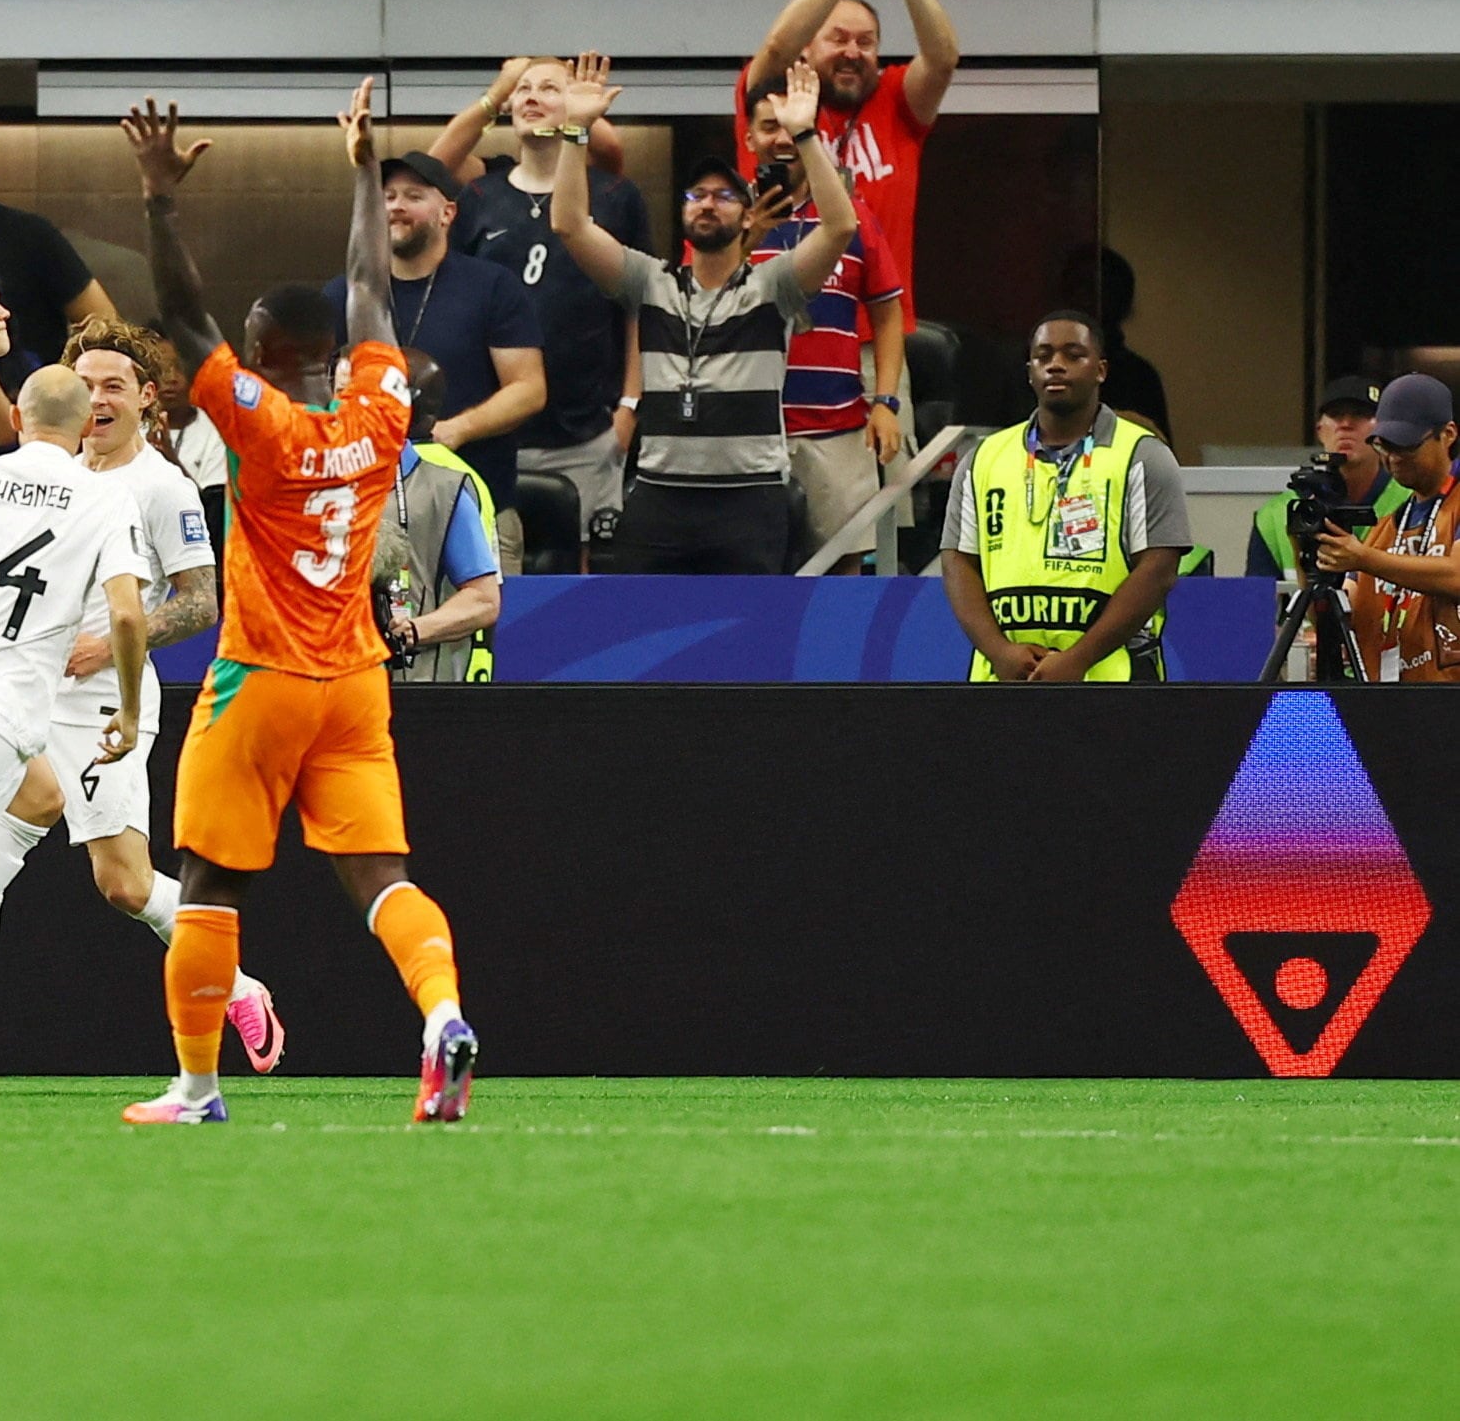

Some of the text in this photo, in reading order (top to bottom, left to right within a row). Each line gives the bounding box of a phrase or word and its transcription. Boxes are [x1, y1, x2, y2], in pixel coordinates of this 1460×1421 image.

[523, 243, 548, 285] 8
[291, 481, 360, 591] 3
[1044, 560, 1103, 575] FIFA.com
[990, 594, 1098, 626] ECURITY
[80, 757, 100, 802] 6
